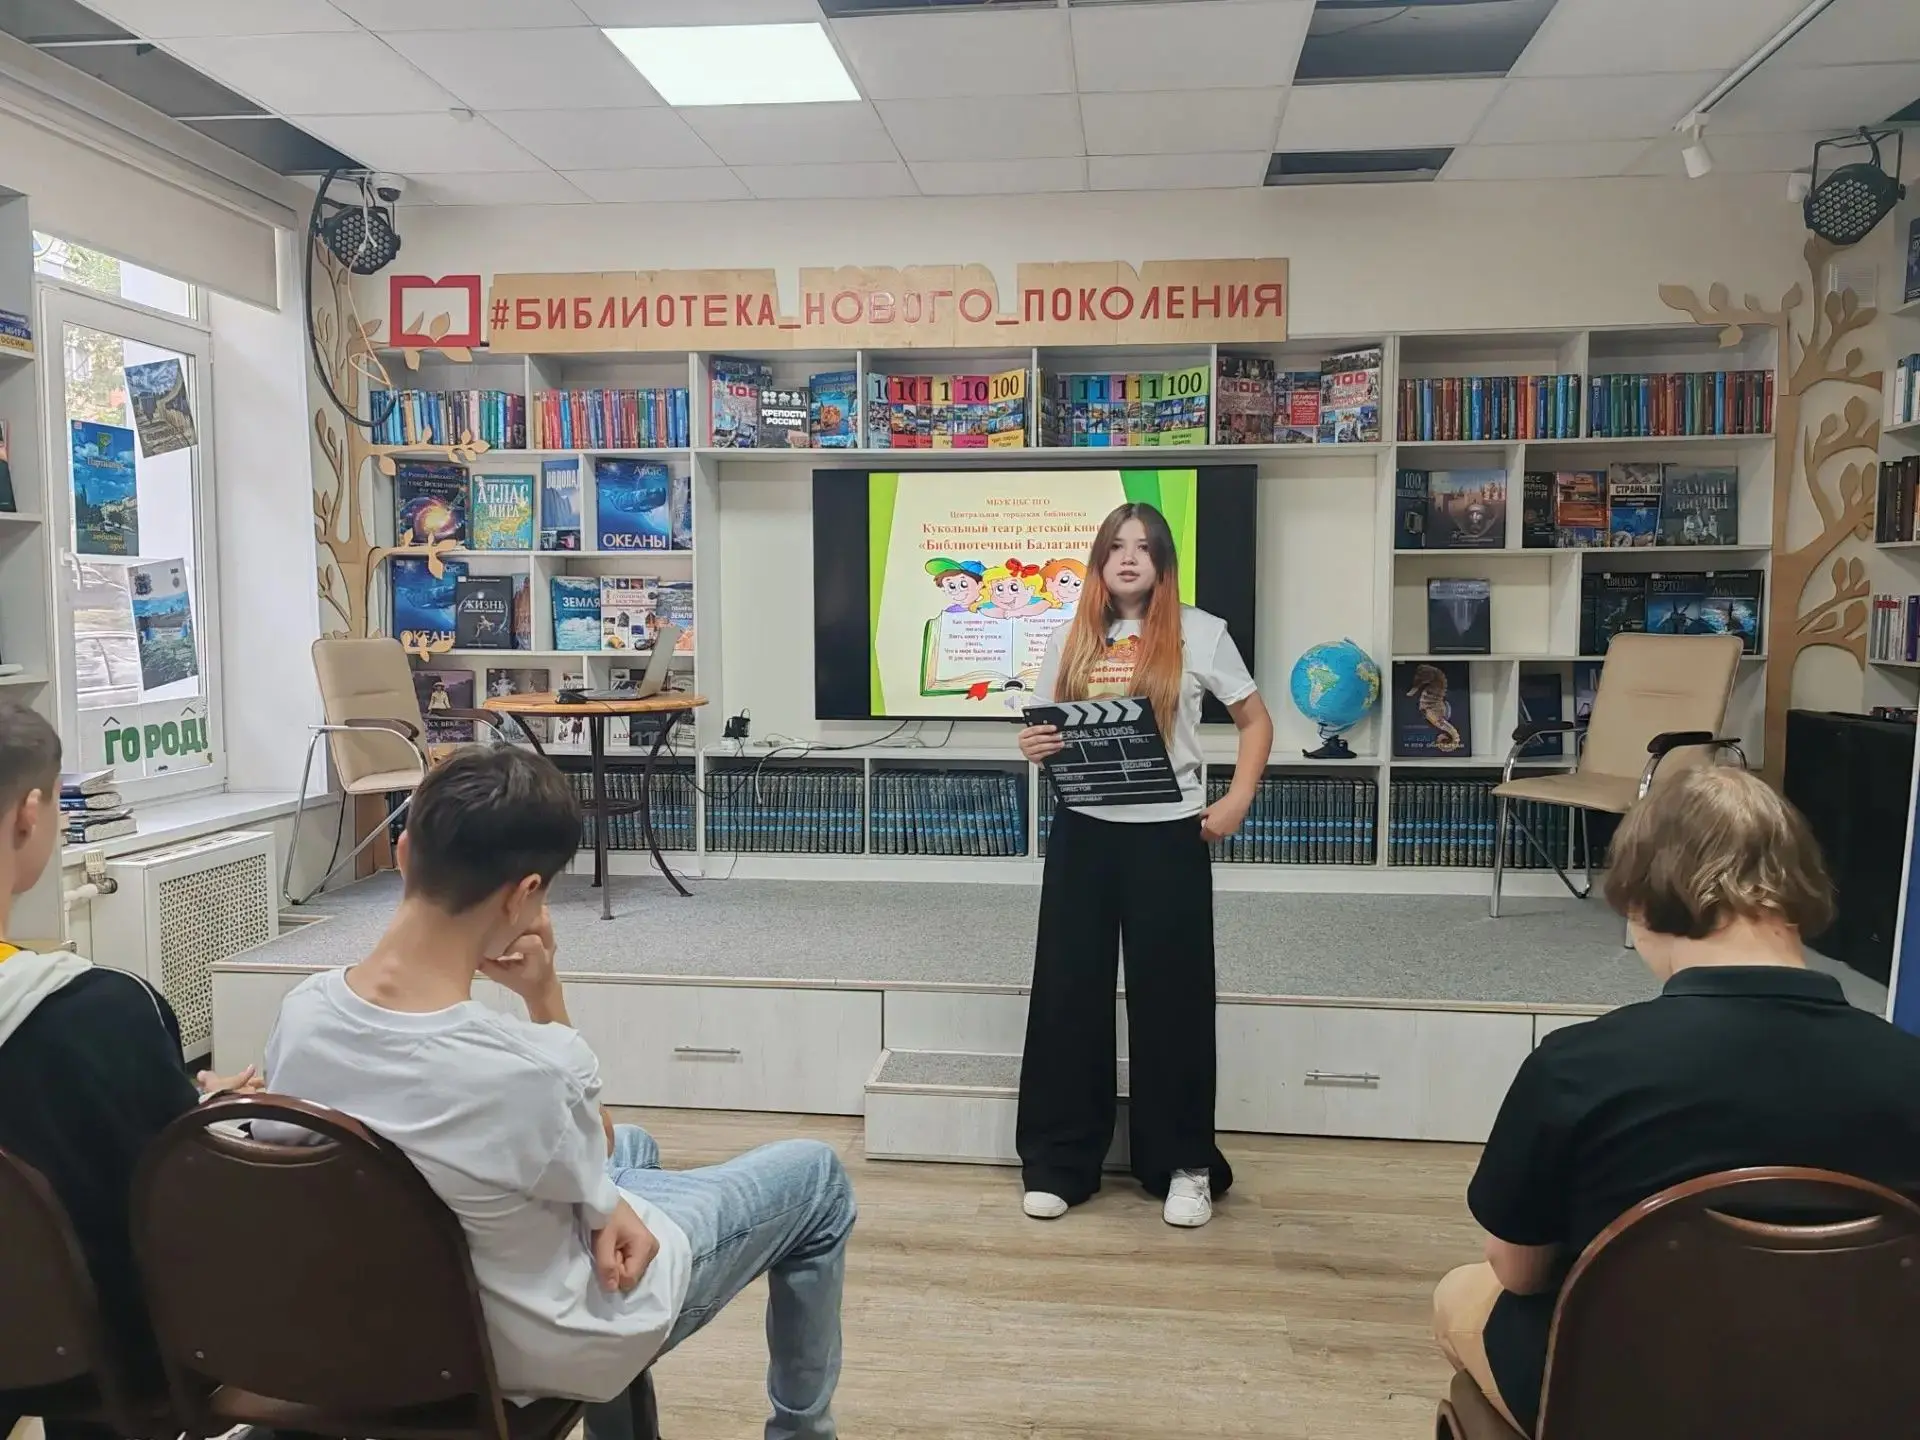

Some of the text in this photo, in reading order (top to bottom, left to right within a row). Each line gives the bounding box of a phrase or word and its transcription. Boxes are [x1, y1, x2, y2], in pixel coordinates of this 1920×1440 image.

[993, 375, 1019, 399] 100
[1168, 372, 1202, 396] 100
[761, 409, 807, 418] КРЕПОСТИ
[766, 417, 802, 425] РОССИИ
[478, 482, 529, 504] АТЛАС
[1615, 485, 1648, 495] СТРАНЫ
[488, 504, 520, 518] МИРА
[950, 510, 1000, 519] Центральная
[1043, 510, 1088, 518] библиотека
[922, 523, 988, 535] Кукольный
[992, 524, 1024, 535] театр
[1026, 523, 1070, 534] детской
[603, 533, 666, 549] ОКЕАНЫ
[919, 538, 1022, 550] «Библиотечный
[463, 600, 505, 610] ЖИЗНЬ
[562, 597, 601, 608] ЗЕМЛЯ
[1060, 725, 1136, 739] ERSAL STUDIOS
